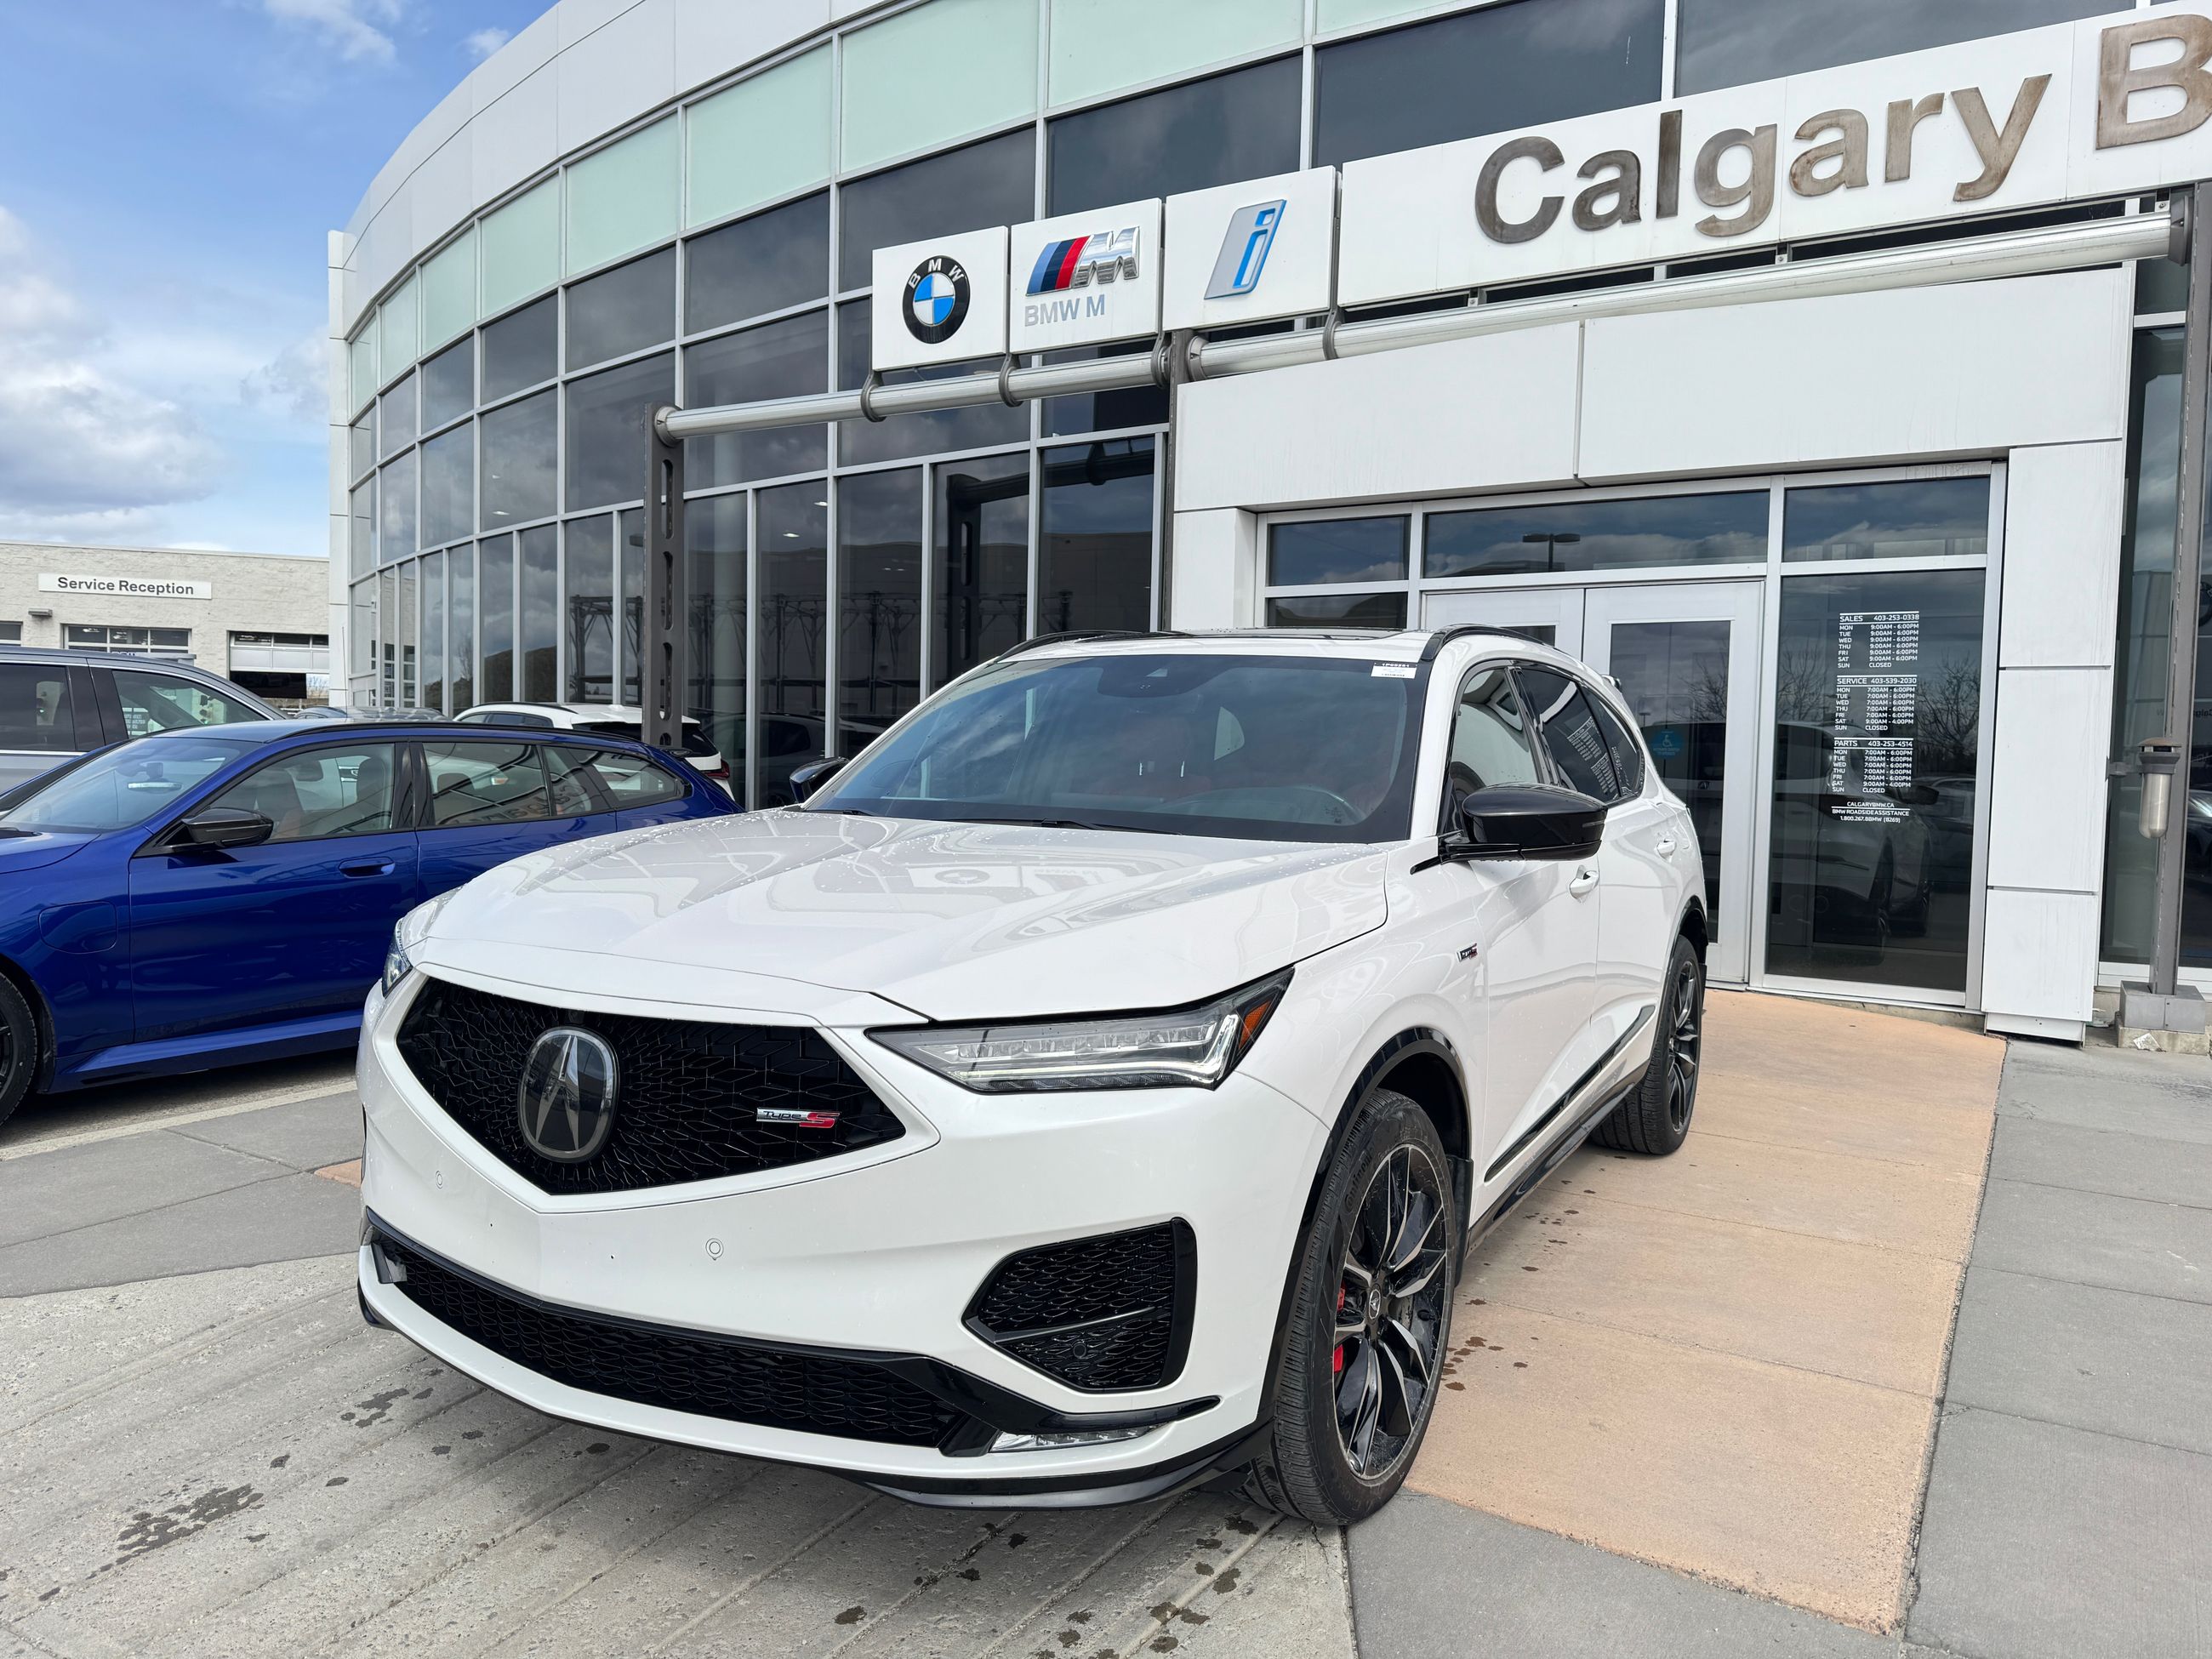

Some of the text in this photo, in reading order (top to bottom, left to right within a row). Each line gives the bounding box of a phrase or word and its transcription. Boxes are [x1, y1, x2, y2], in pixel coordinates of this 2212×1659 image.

[1474, 72, 2053, 244] Calgary
[907, 258, 965, 289] BMW
[1024, 294, 1105, 327] BMW M
[57, 576, 194, 596] Service Reception
[762, 1110, 841, 1128] Type S
